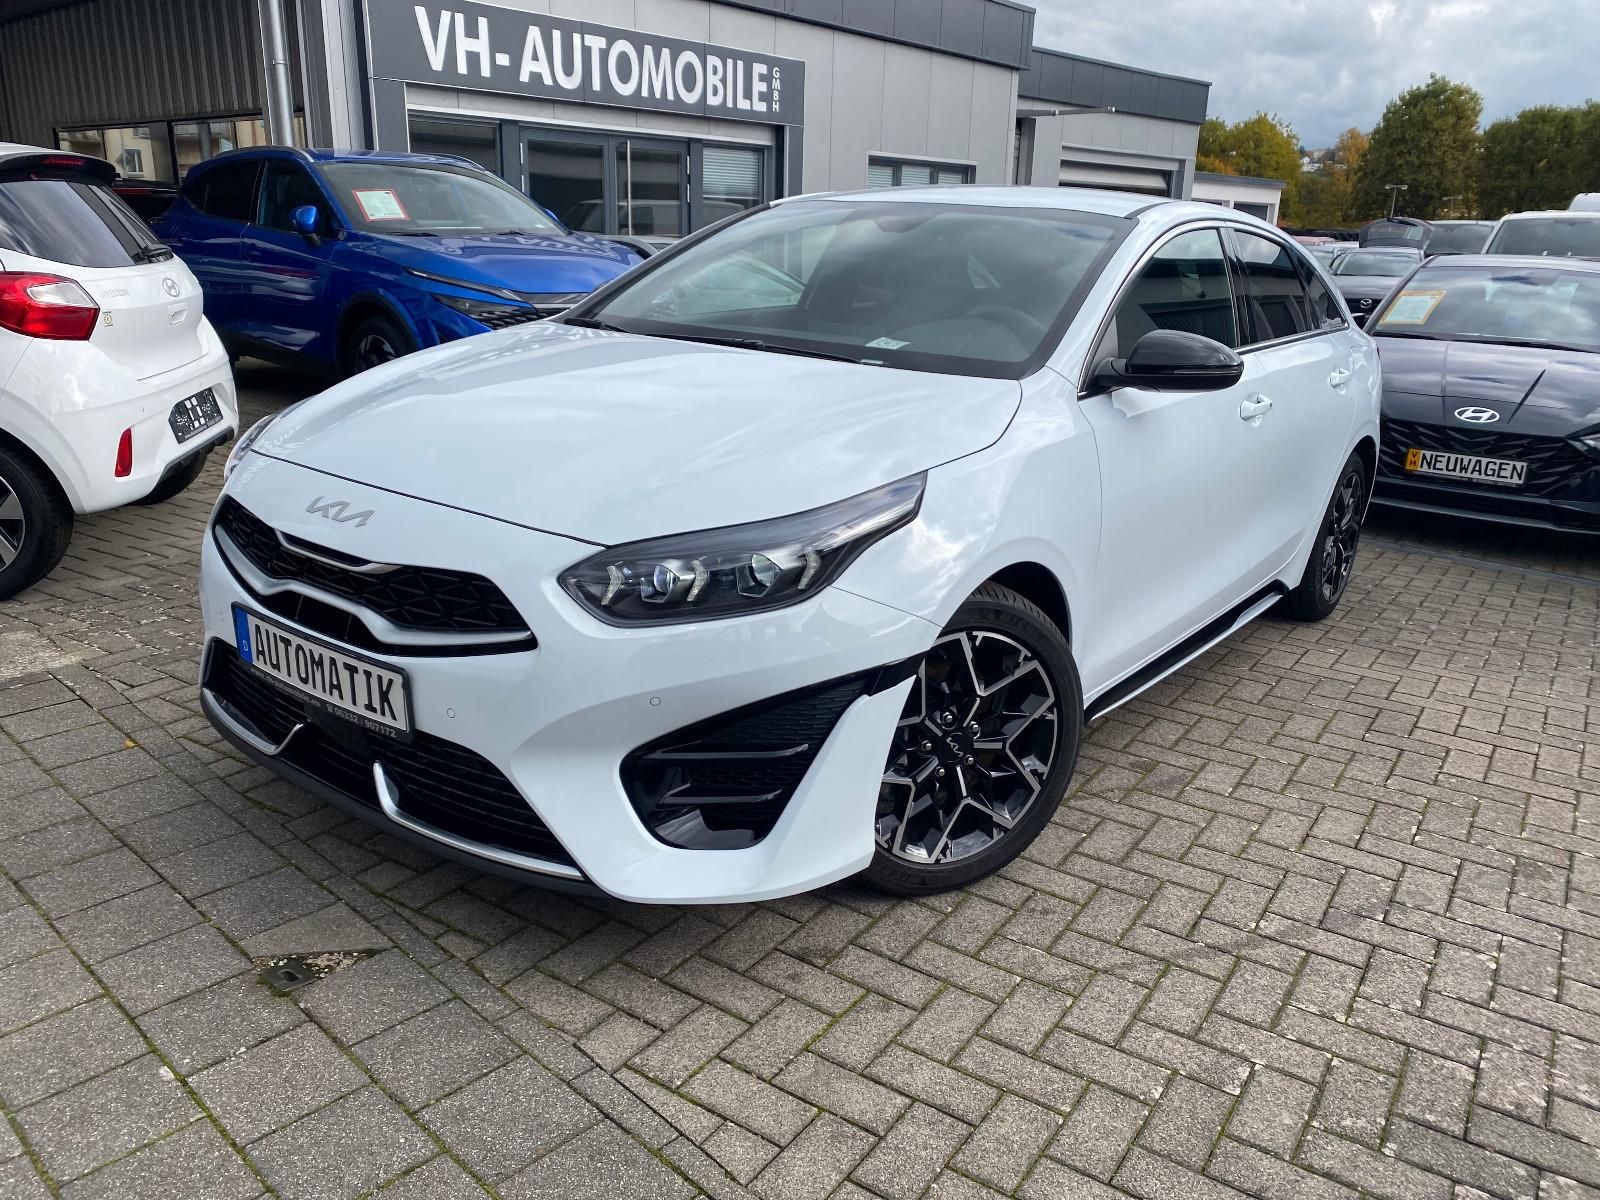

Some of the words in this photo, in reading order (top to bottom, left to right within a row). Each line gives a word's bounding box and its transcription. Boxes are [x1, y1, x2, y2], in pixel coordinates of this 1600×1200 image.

[414, 6, 510, 78] VH-
[519, 26, 767, 112] AUTOMOBILE
[772, 67, 780, 112] GMBH
[1420, 453, 1525, 481] NEUWAGEN
[242, 640, 249, 651] D
[254, 623, 397, 721] AUTOMATIK
